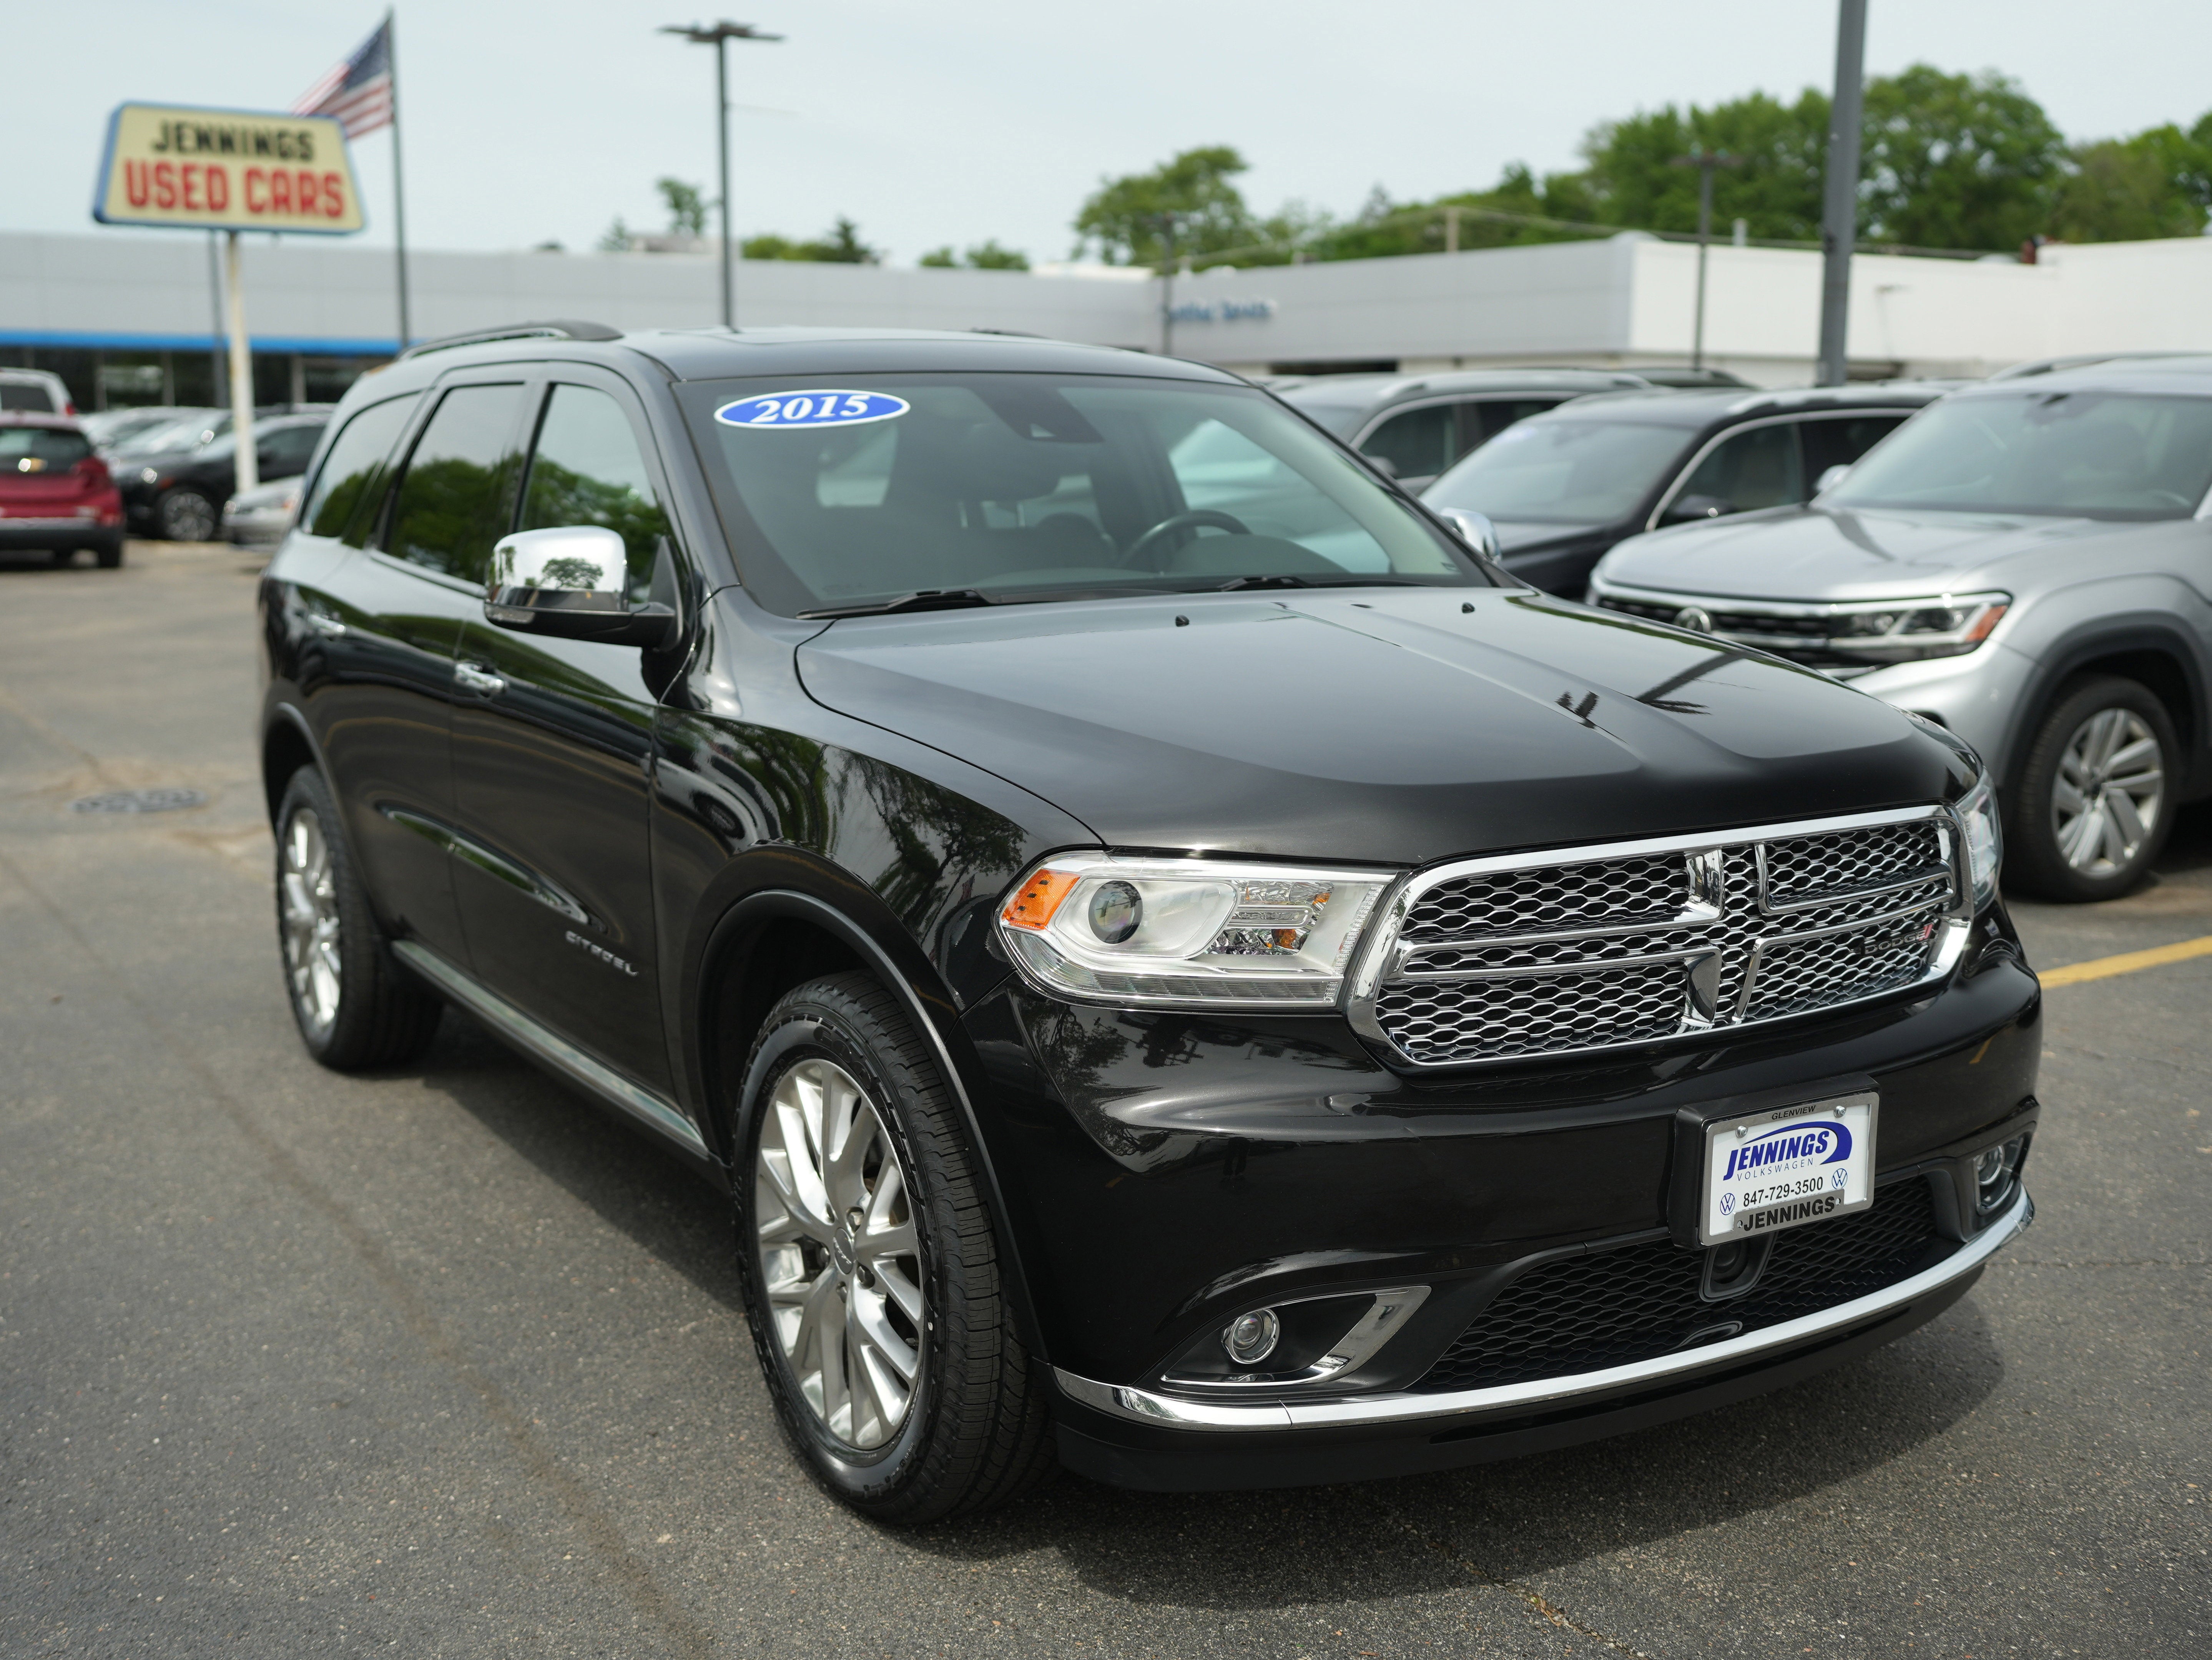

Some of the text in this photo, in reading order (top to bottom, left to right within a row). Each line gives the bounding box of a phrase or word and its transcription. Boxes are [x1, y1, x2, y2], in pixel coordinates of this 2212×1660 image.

[151, 120, 314, 163] JENNINGS
[125, 159, 344, 218] USED CARS
[750, 394, 871, 423] 2015
[1865, 929, 1926, 954] DODGE
[1772, 1105, 1816, 1120] GLENVIEW
[1723, 1130, 1830, 1181] JENNINGS
[1737, 1158, 1813, 1182] VOLKSWAGEN
[1743, 1176, 1823, 1207] 847-729-3500
[1743, 1196, 1835, 1232] JENNINGS
